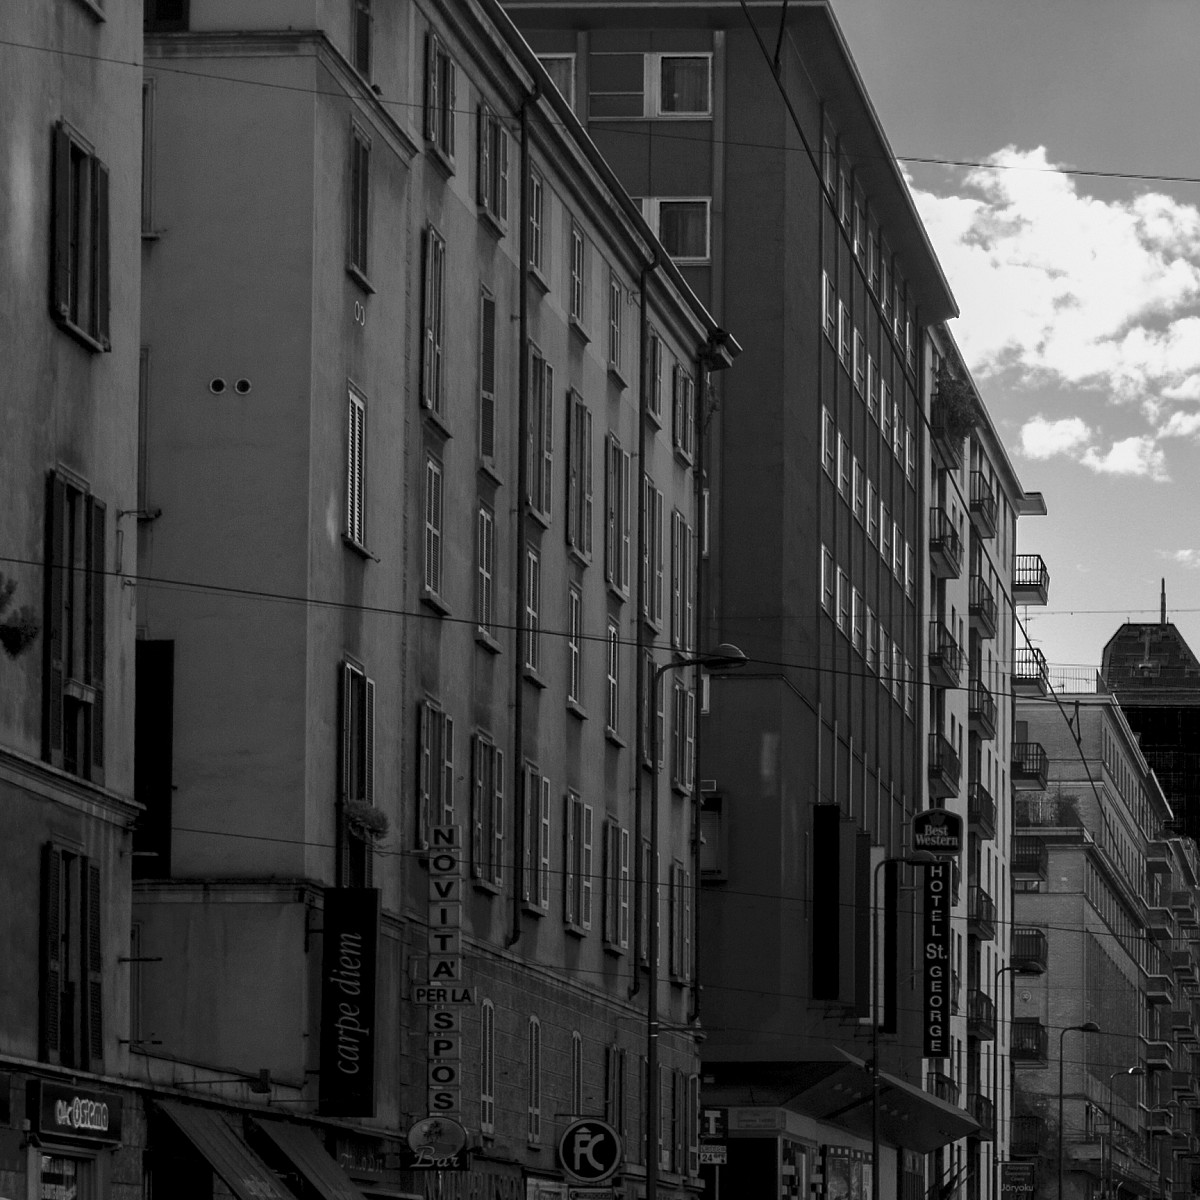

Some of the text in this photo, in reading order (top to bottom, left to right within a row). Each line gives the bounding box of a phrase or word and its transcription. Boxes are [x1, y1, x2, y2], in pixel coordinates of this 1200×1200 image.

[915, 833, 959, 847] Western
[924, 825, 949, 836] Best
[930, 865, 943, 938] HOTEL
[926, 942, 948, 960] St.
[330, 932, 370, 1076] carpe diem
[416, 988, 471, 1003] PER LA
[930, 965, 943, 1053] GEORGE
[704, 1110, 721, 1135] T
[410, 1145, 461, 1168] Bar
